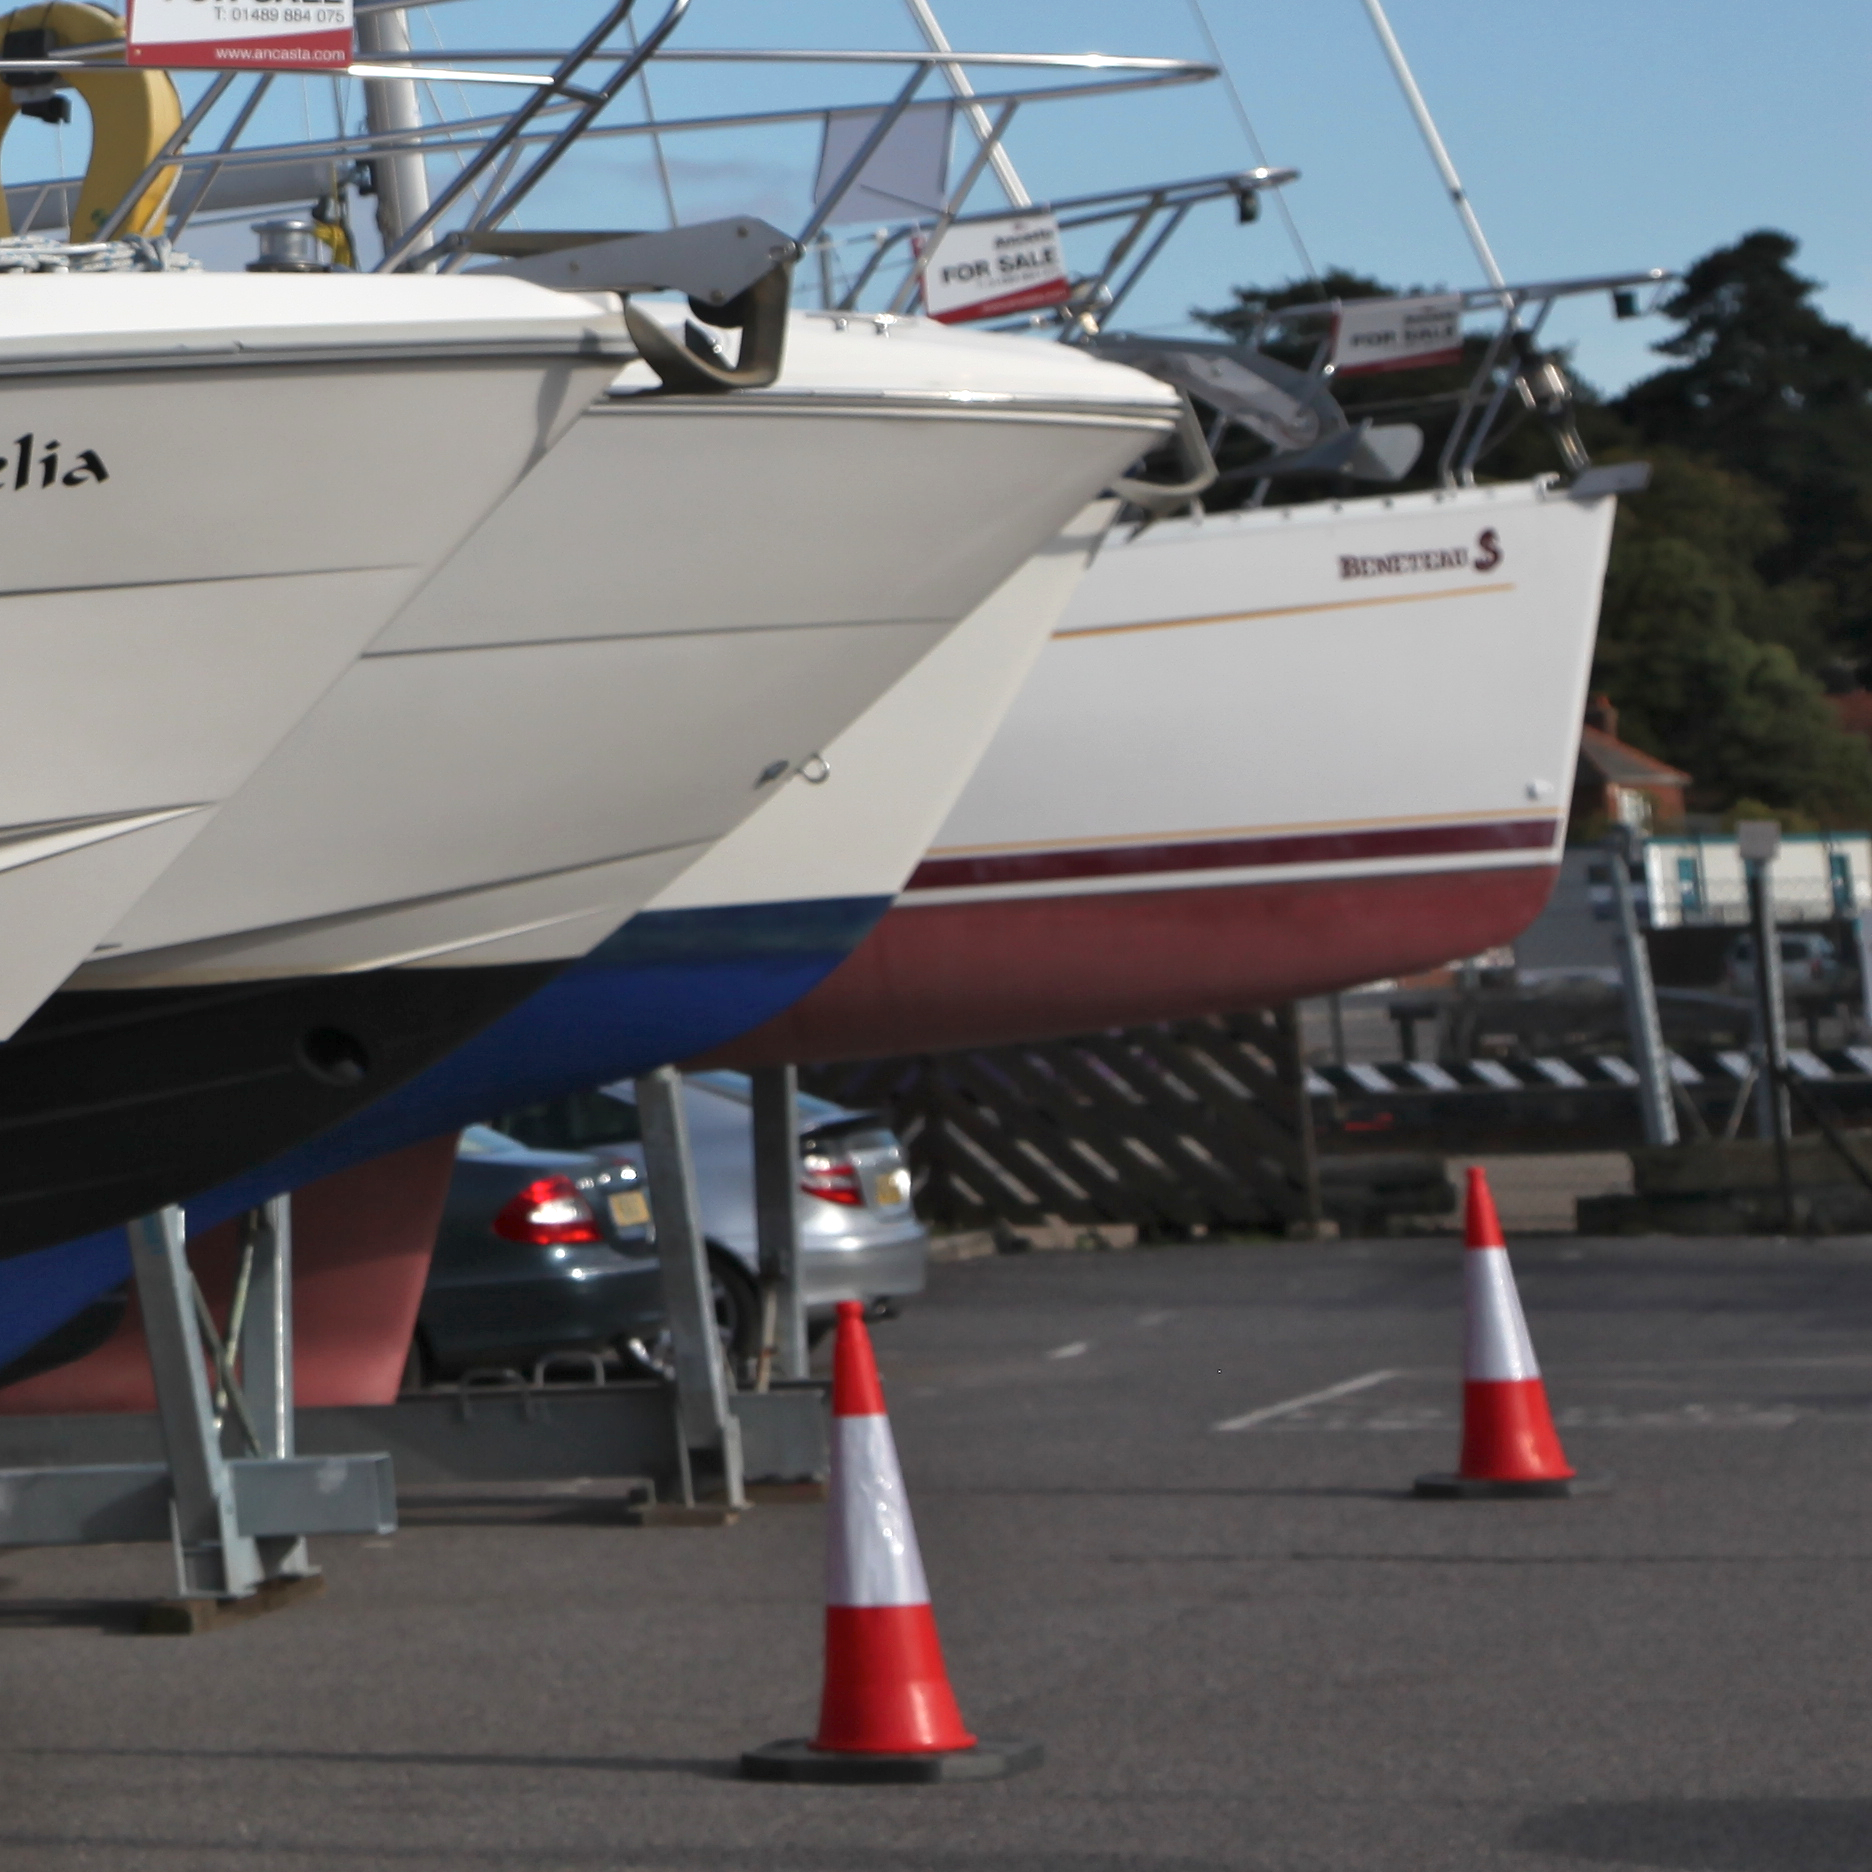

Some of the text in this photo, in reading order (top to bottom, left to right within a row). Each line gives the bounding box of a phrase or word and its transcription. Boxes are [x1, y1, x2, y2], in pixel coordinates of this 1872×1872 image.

[214, 6, 345, 24] T: 01489 884 075
[215, 46, 346, 62] www.ancasta.com
[942, 258, 991, 283] FOR
[998, 247, 1056, 273] SALE
[1339, 546, 1468, 580] BENETEAU
